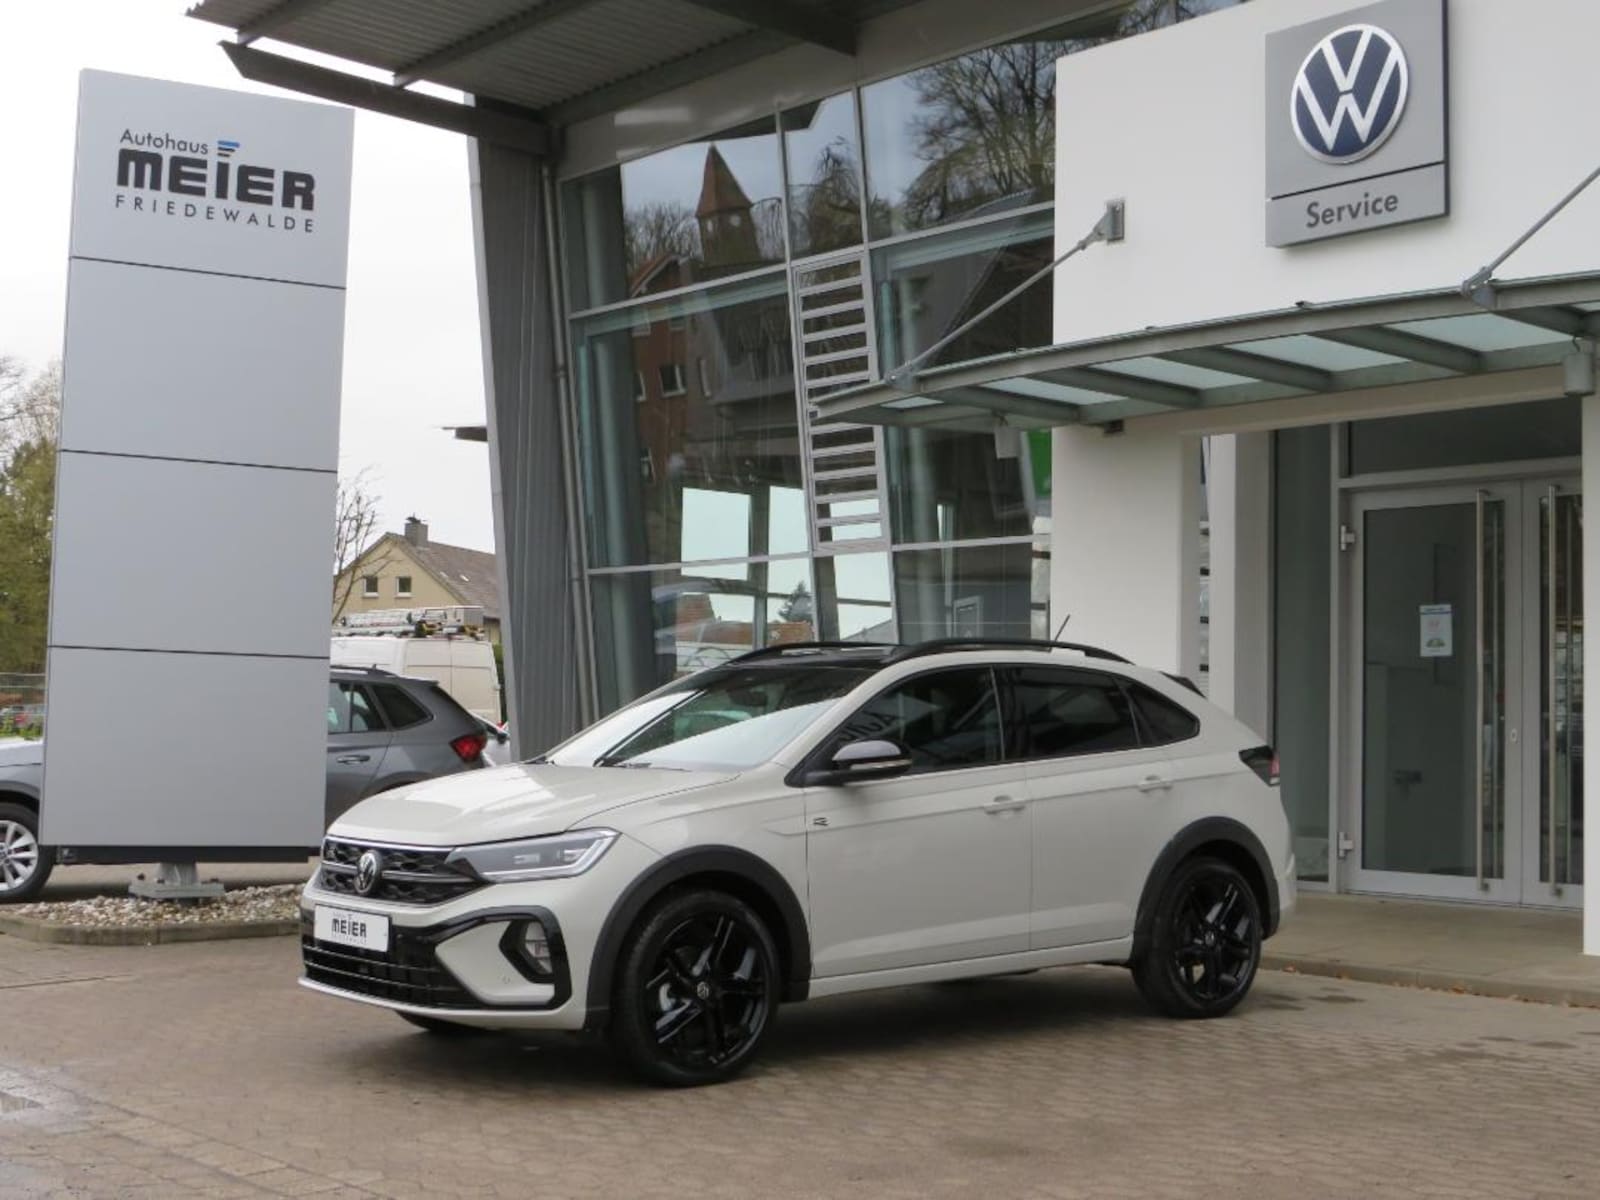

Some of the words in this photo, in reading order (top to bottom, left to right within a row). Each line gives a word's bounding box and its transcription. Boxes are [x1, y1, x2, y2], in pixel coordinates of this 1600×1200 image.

[1293, 26, 1406, 155] VW
[119, 128, 209, 156] Autohaus
[116, 141, 315, 211] MEIER
[115, 194, 314, 233] FRIEDEWALDE
[1305, 191, 1399, 229] Service
[331, 915, 367, 938] MEIER
